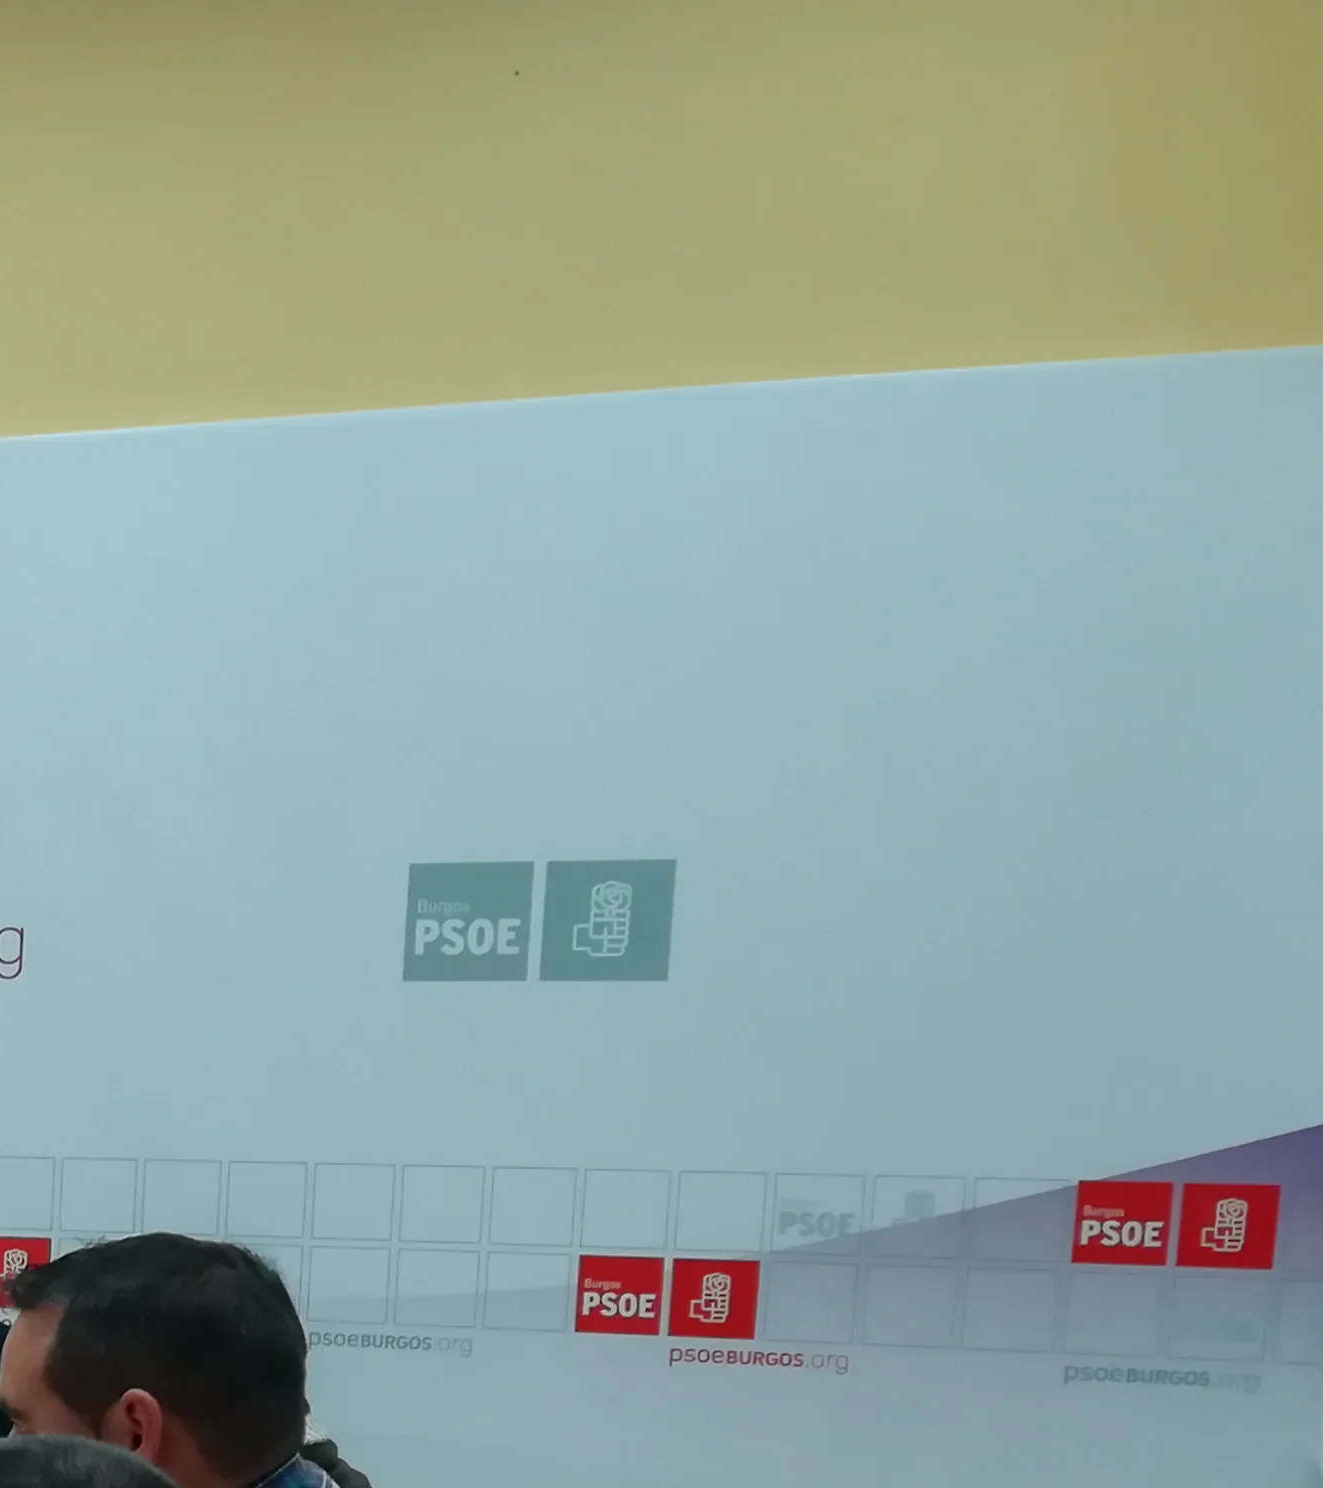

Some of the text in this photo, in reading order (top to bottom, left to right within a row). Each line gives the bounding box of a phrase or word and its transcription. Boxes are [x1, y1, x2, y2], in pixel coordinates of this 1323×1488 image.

[413, 917, 522, 956] PSOE
[1079, 1219, 1165, 1248] PSOE
[581, 1292, 657, 1319] PSOE
[668, 1347, 850, 1376] psoeBURGOS.org
